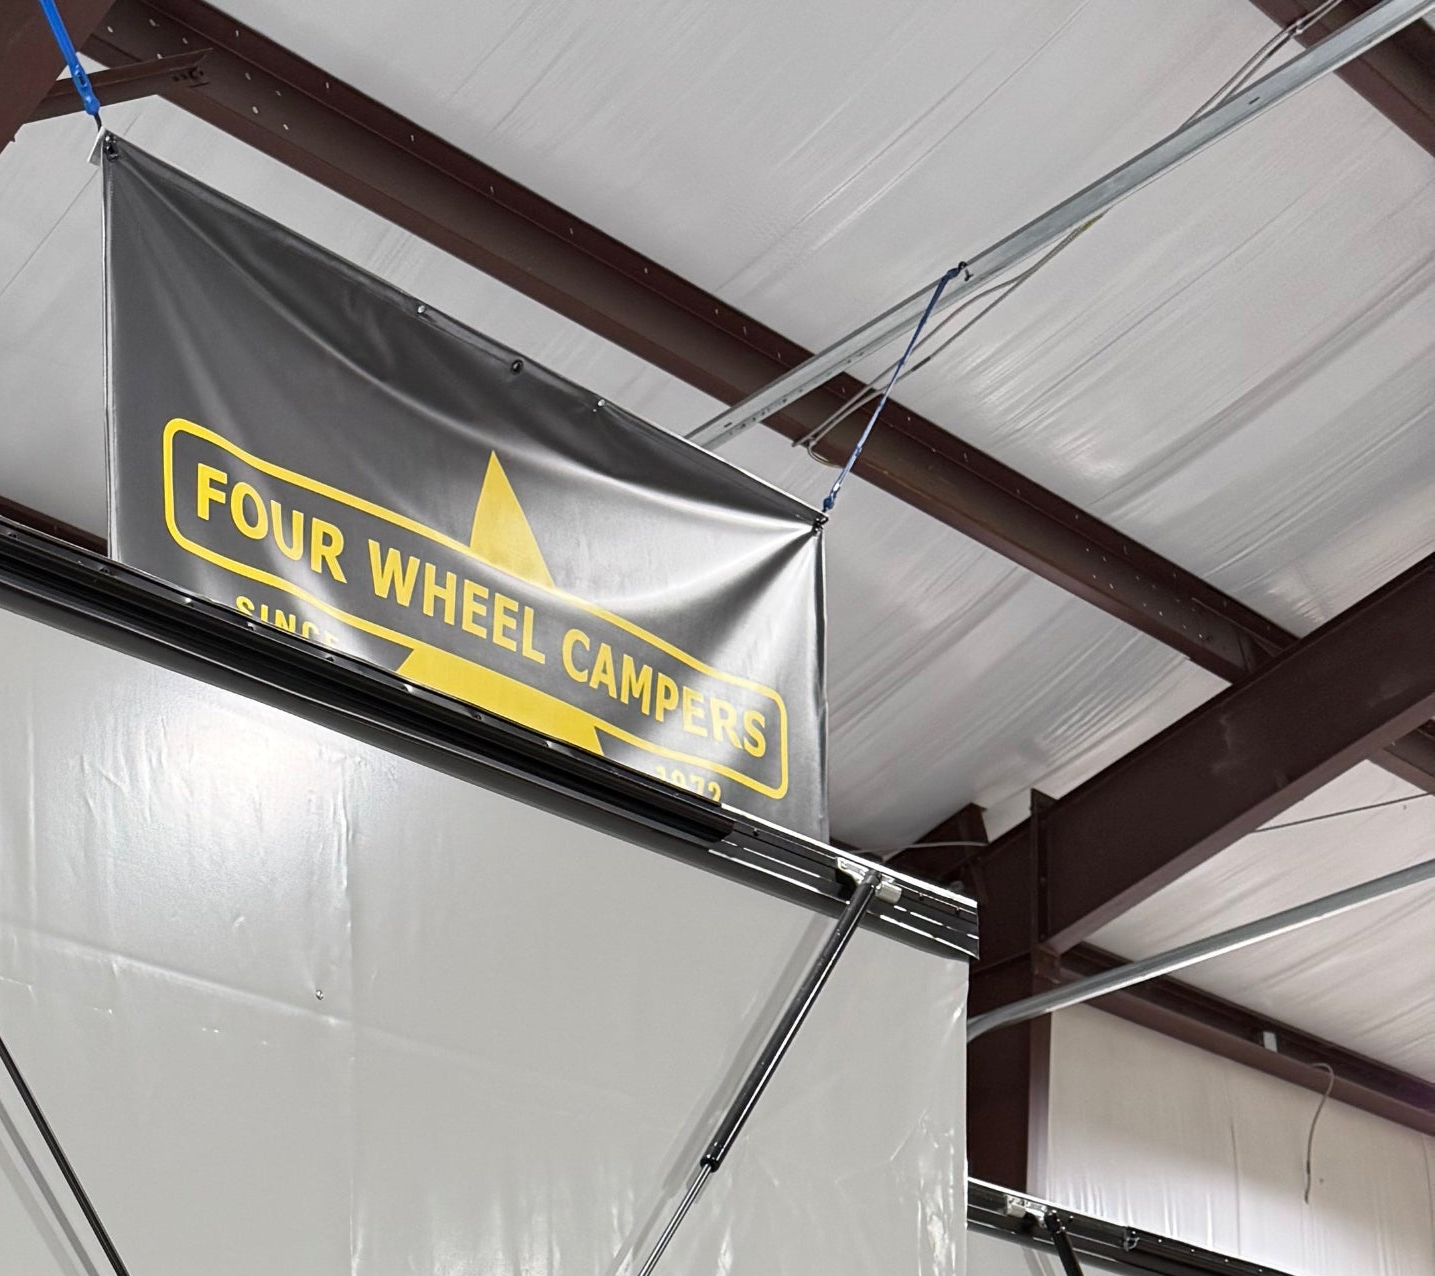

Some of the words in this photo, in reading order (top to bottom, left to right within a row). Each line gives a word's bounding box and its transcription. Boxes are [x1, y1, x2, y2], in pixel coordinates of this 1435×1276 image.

[197, 463, 347, 584] FOUR
[368, 539, 546, 664] WHEEL
[562, 628, 766, 758] CAMPERS
